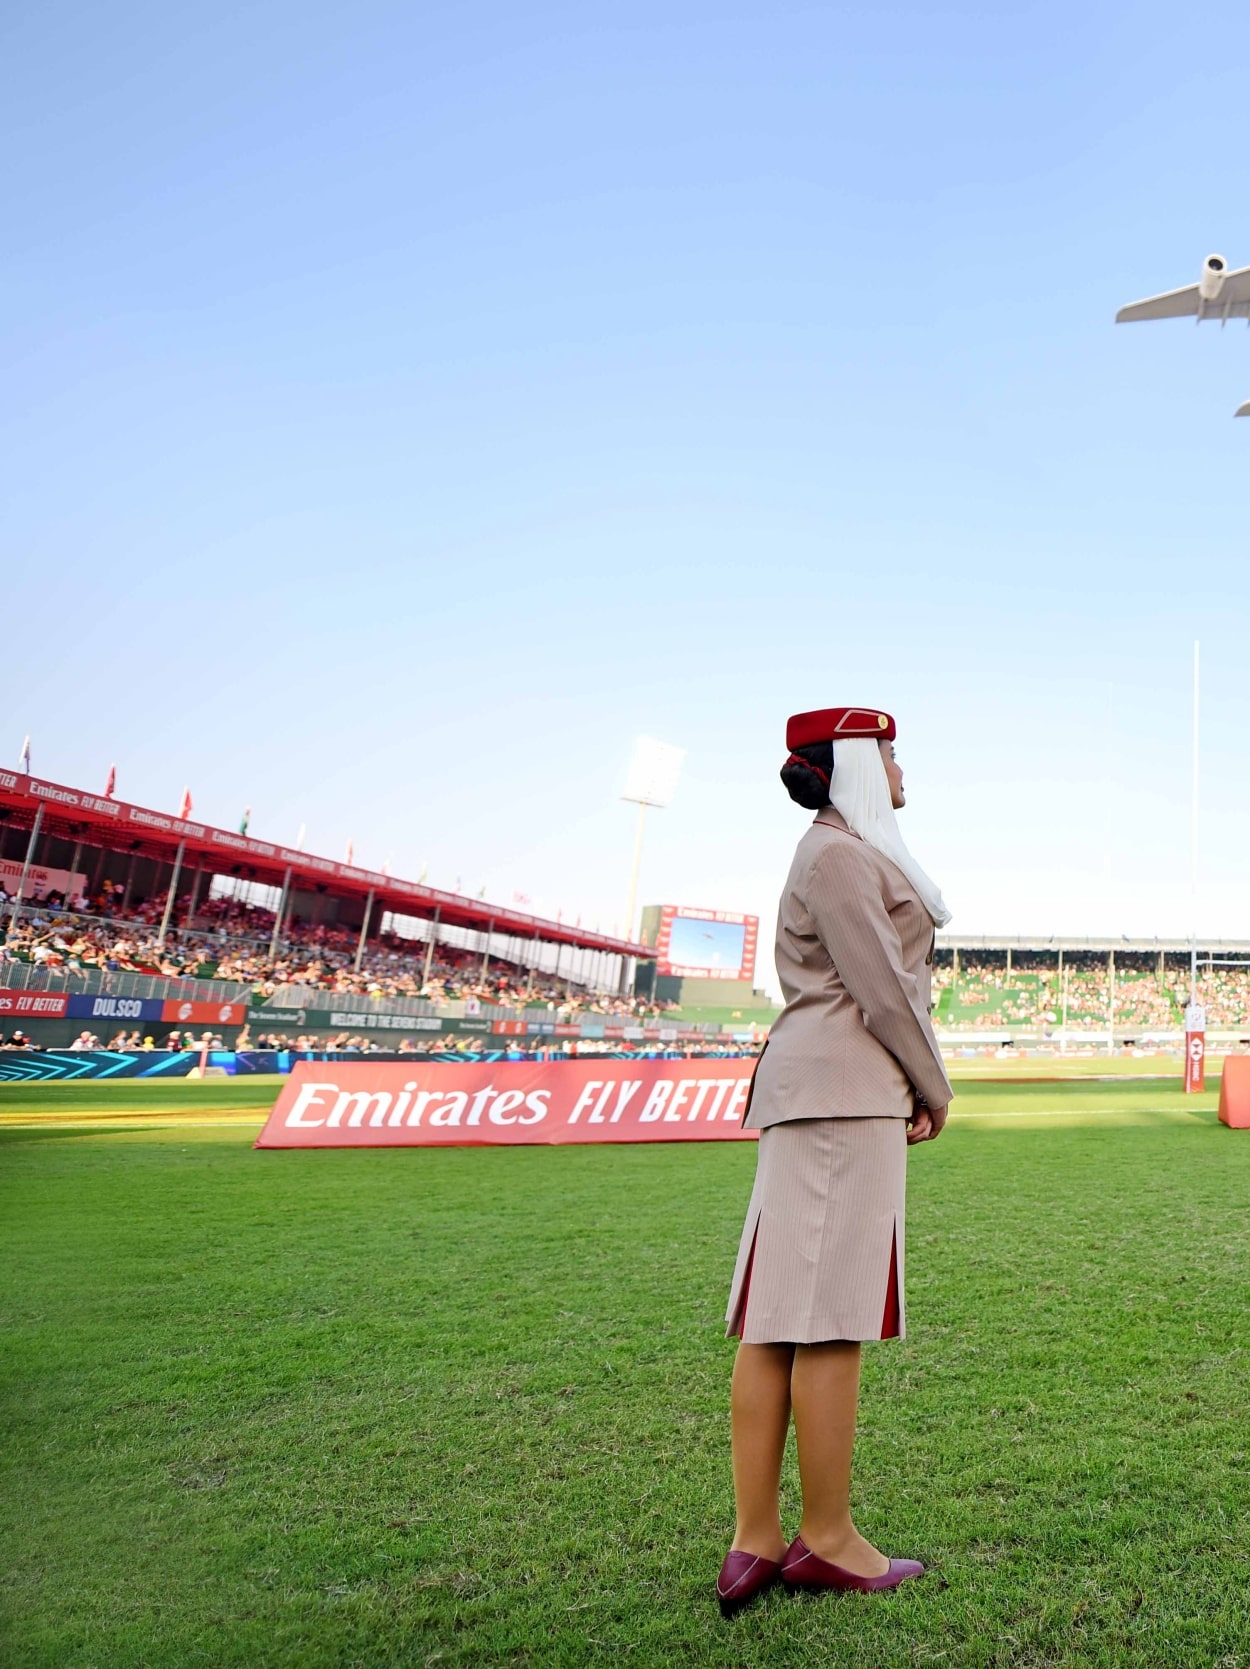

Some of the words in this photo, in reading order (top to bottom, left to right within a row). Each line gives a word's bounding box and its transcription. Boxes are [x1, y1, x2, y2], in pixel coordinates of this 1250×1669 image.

[29, 781, 79, 805] Emirates
[80, 796, 94, 808] FLY
[94, 801, 120, 816] BETTER
[129, 808, 171, 828] Emirates
[16, 996, 33, 1010] FLY
[32, 998, 64, 1012] BETTER
[92, 998, 142, 1017] DULSCO
[285, 1081, 552, 1128] Emirates
[567, 1079, 643, 1125] FLY
